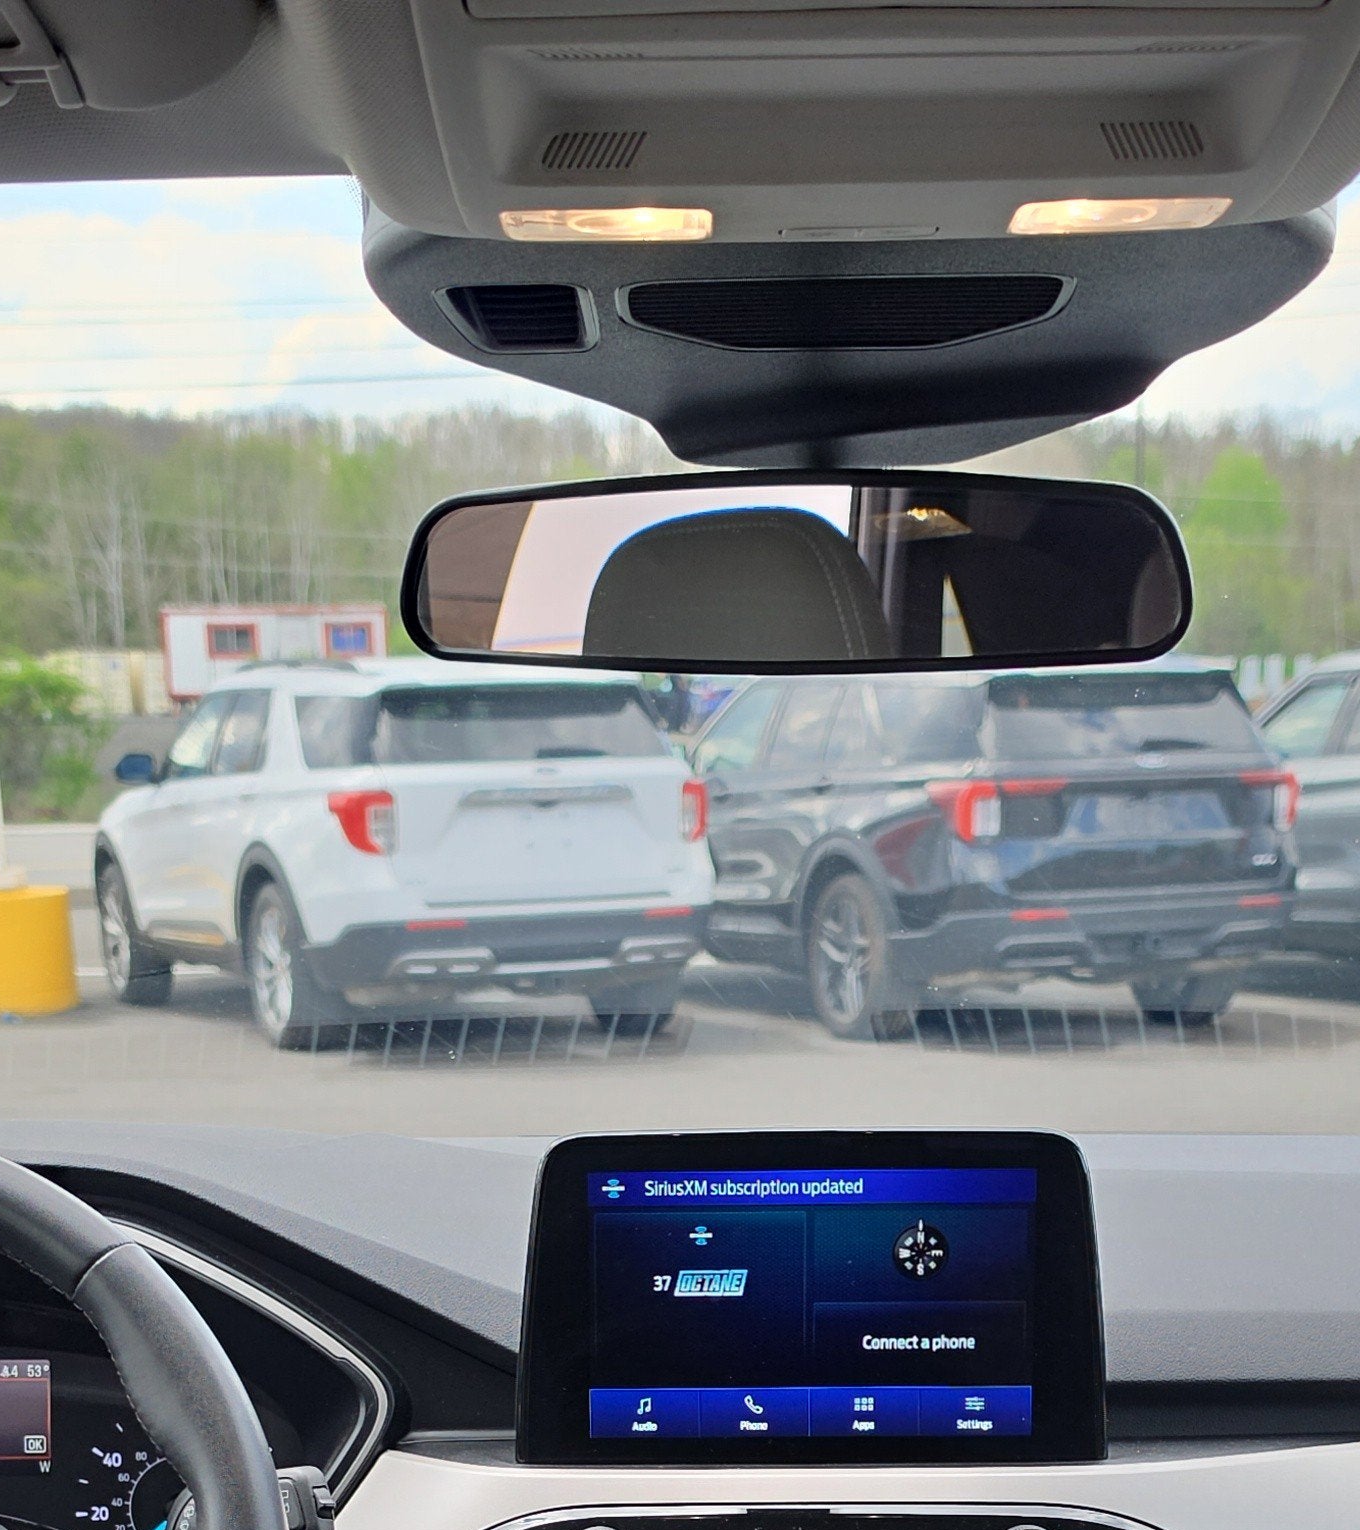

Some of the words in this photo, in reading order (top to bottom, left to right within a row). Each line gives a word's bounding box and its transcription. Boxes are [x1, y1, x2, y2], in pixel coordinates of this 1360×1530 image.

[644, 1178, 708, 1197] SiriusXM
[709, 1178, 799, 1199] subscription
[801, 1177, 864, 1197] updated
[652, 1275, 672, 1292] 37
[676, 1271, 745, 1295] OCTANE
[862, 1334, 919, 1350] Connect
[920, 1338, 930, 1350] a
[931, 1334, 976, 1354] phone
[632, 1420, 658, 1431] Audio
[740, 1419, 768, 1431] Phone
[852, 1419, 875, 1432] Apps
[956, 1418, 993, 1432] Settings
[27, 1438, 43, 1451] OK
[40, 1460, 51, 1473] W
[102, 1452, 123, 1468] 40
[111, 1497, 123, 1507] 40
[91, 1506, 110, 1521] 20
